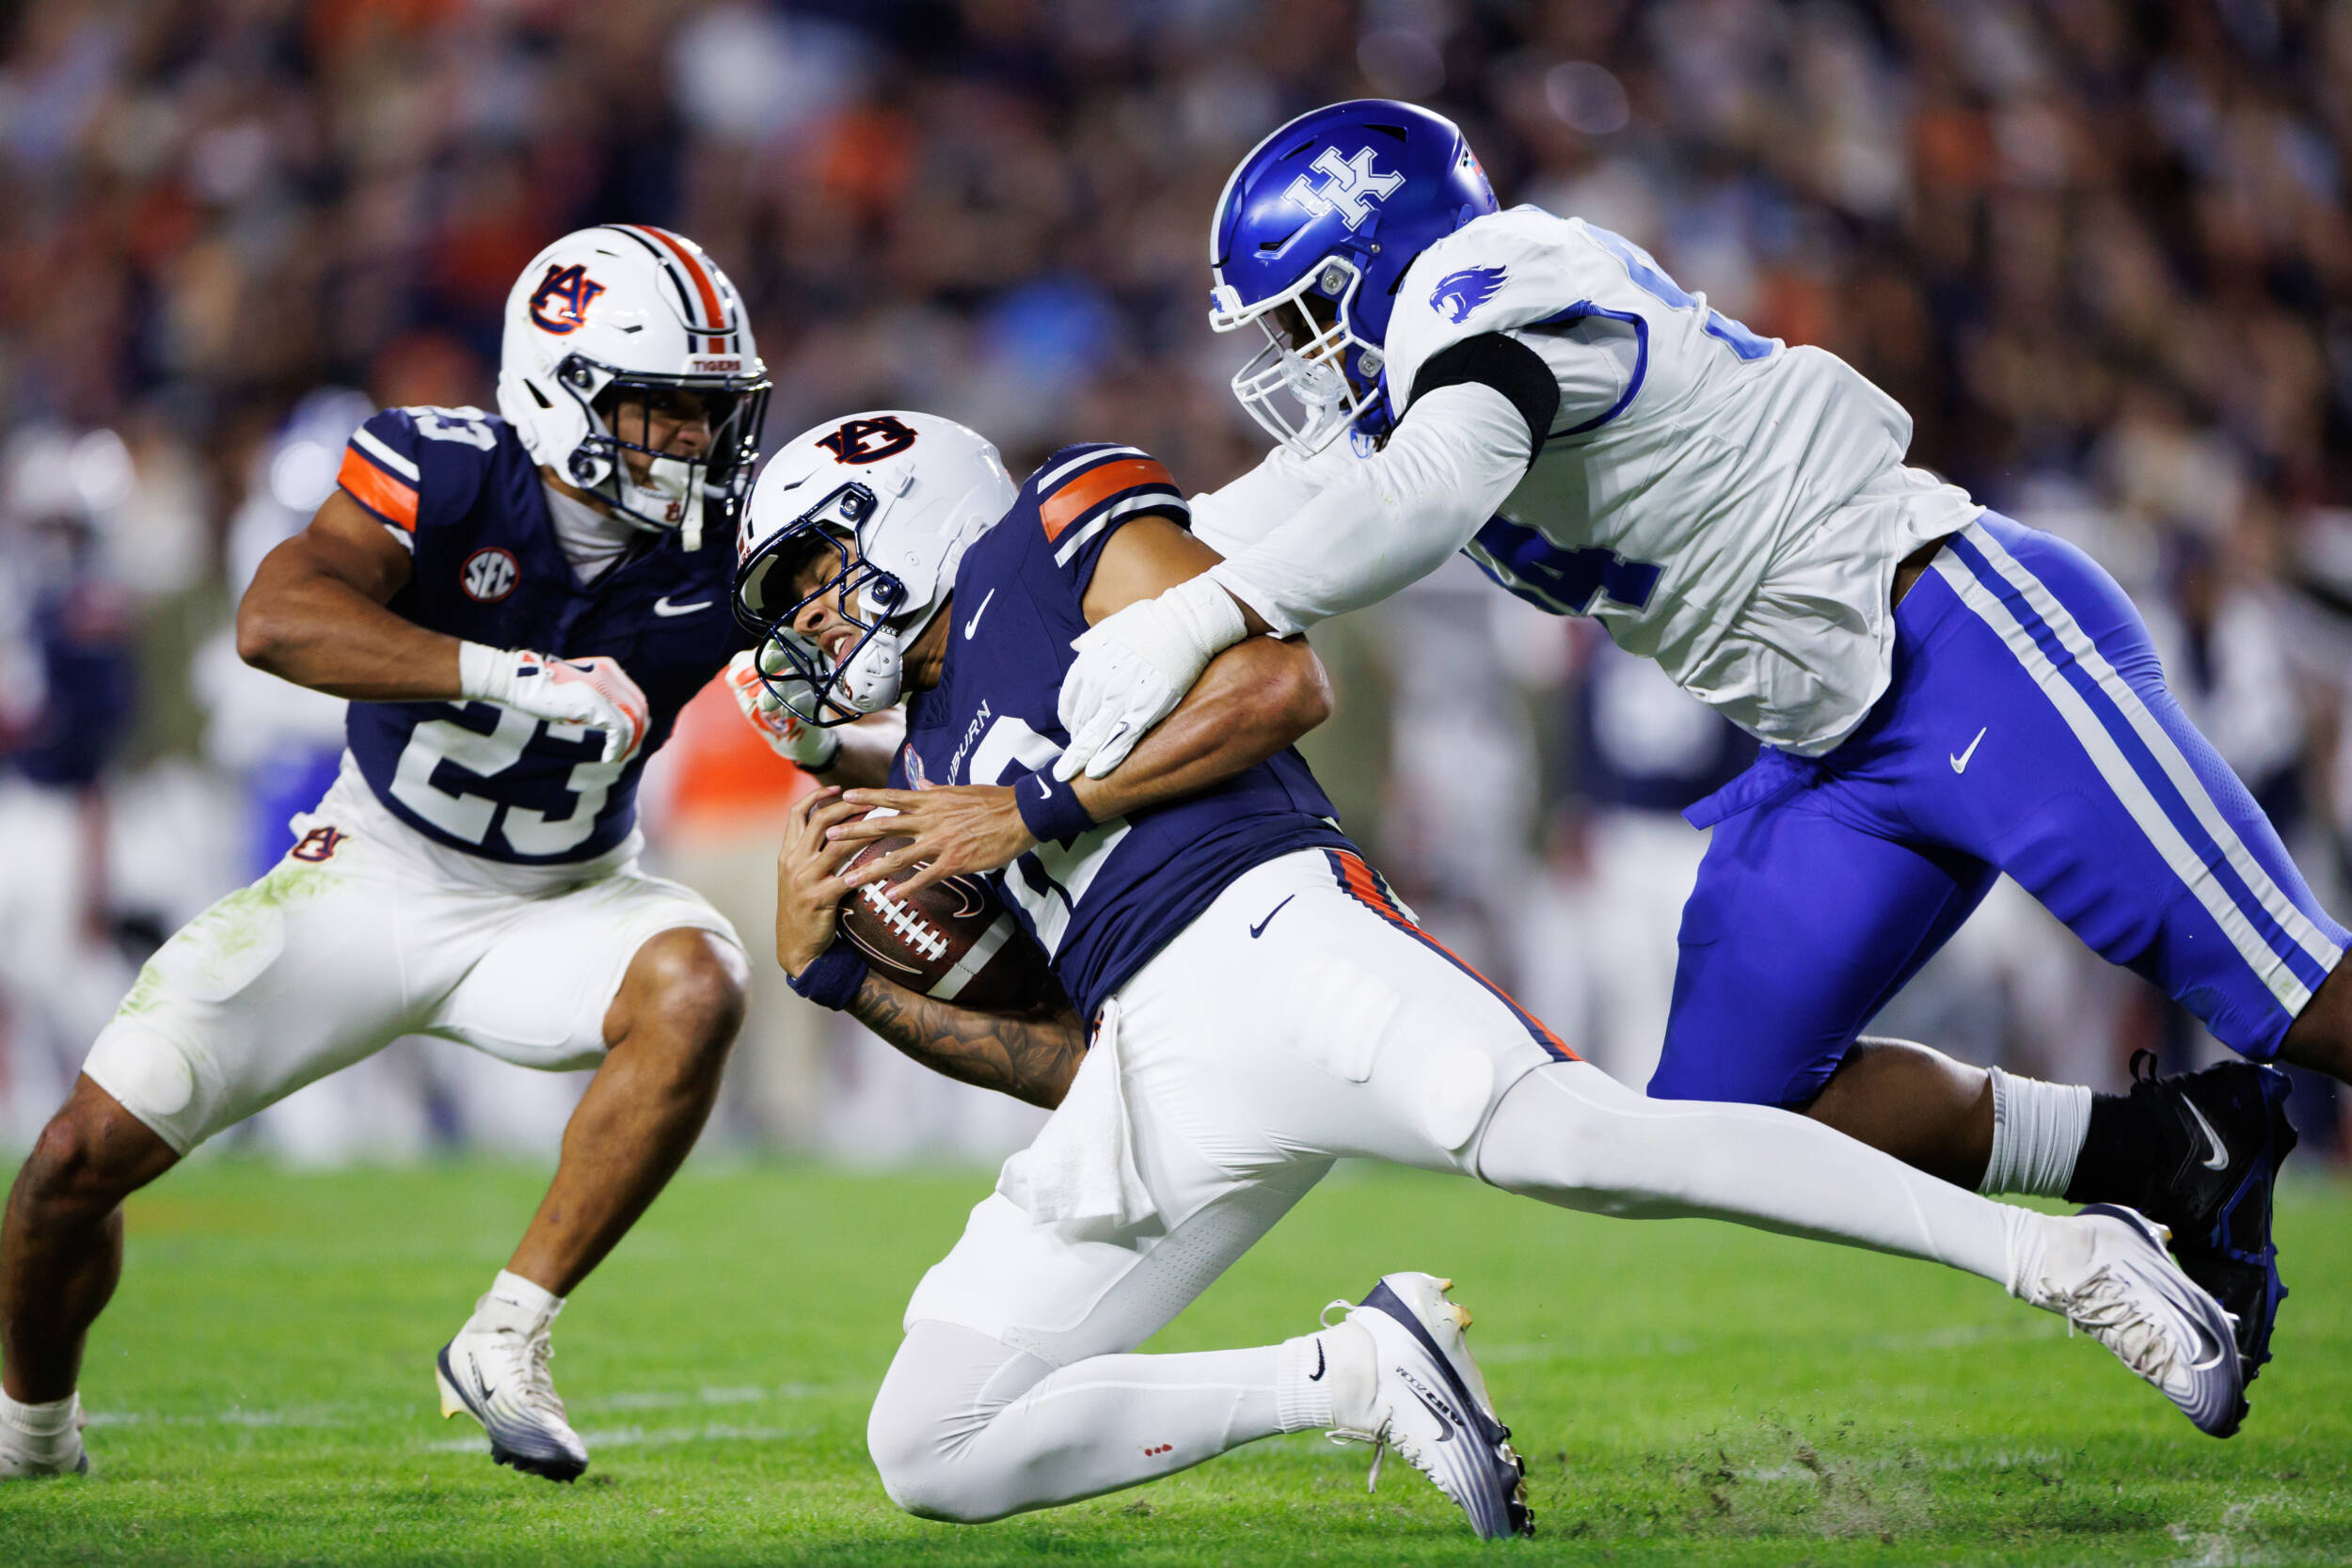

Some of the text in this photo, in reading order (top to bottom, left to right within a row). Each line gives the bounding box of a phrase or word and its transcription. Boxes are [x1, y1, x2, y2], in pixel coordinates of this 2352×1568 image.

[692, 360, 741, 372] TIGERS
[465, 551, 516, 598] SEC
[1458, 512, 1669, 618] 4
[389, 700, 627, 857] 23
[947, 699, 991, 786] UBURN
